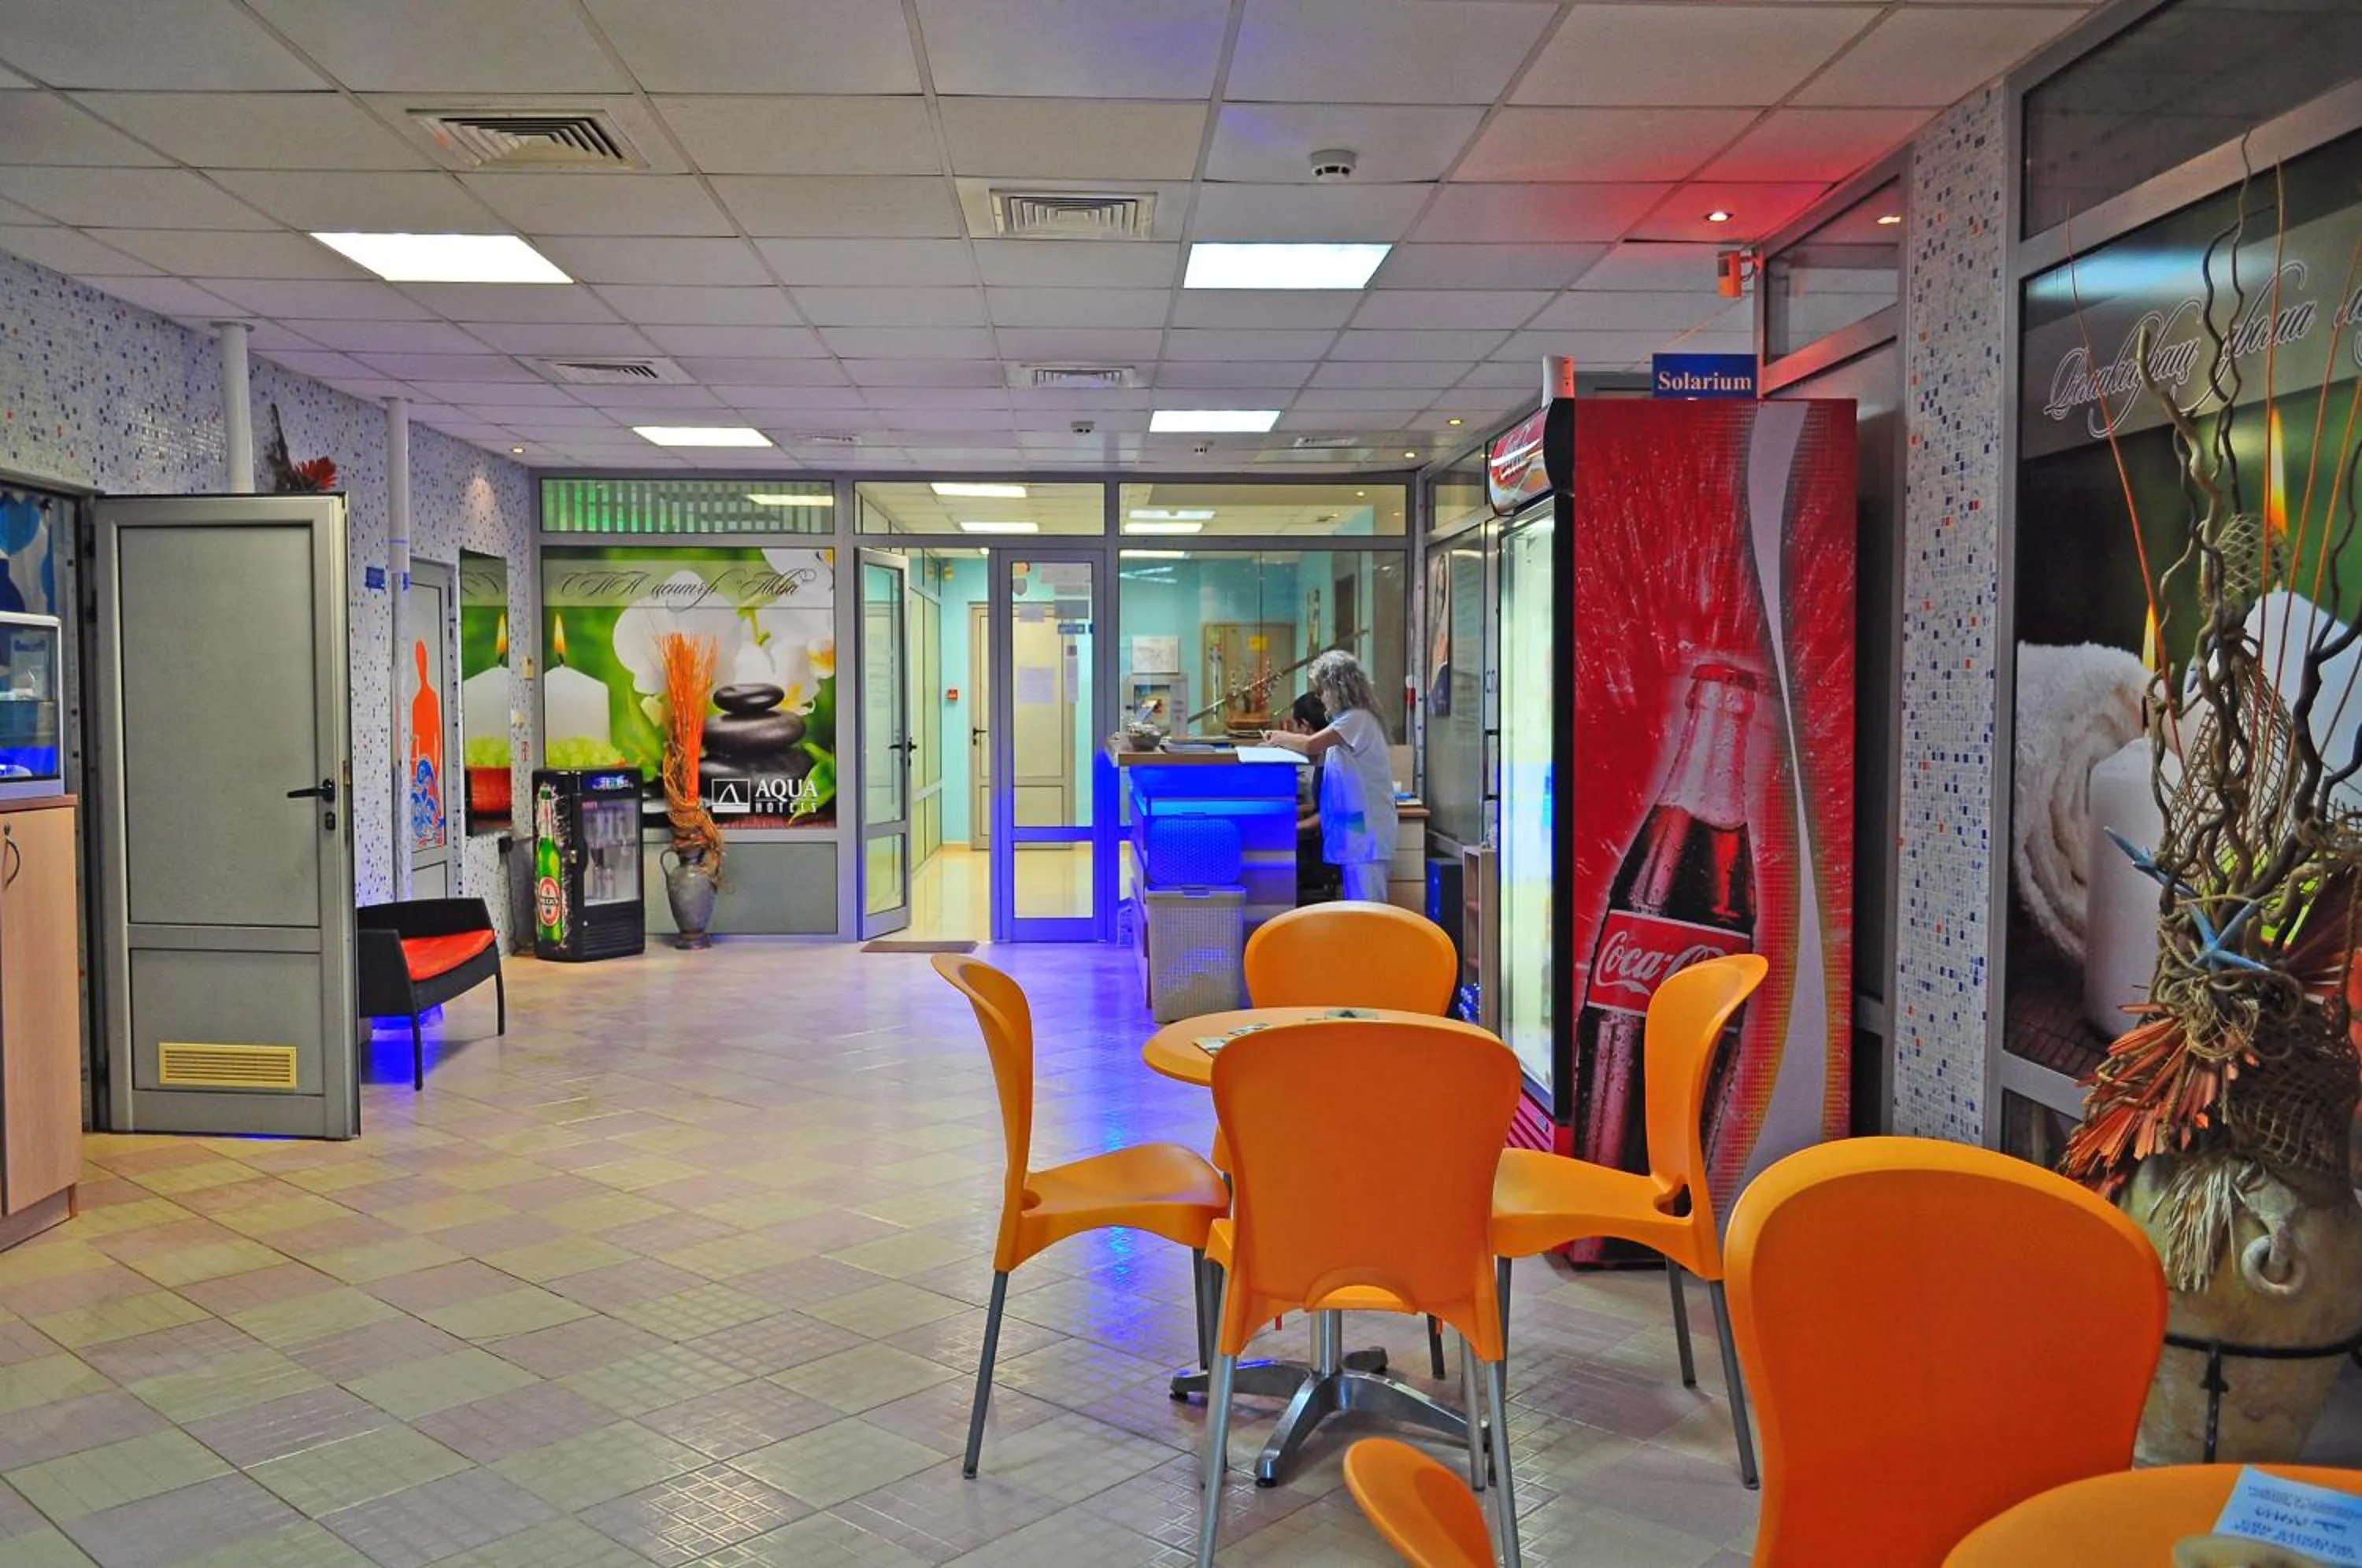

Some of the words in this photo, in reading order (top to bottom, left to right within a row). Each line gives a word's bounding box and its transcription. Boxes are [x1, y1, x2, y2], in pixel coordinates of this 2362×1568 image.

[1658, 372, 1752, 390] Solarium
[755, 778, 818, 802] AQUA
[755, 802, 817, 813] HOTELS
[1595, 930, 1727, 997] Coca-C
